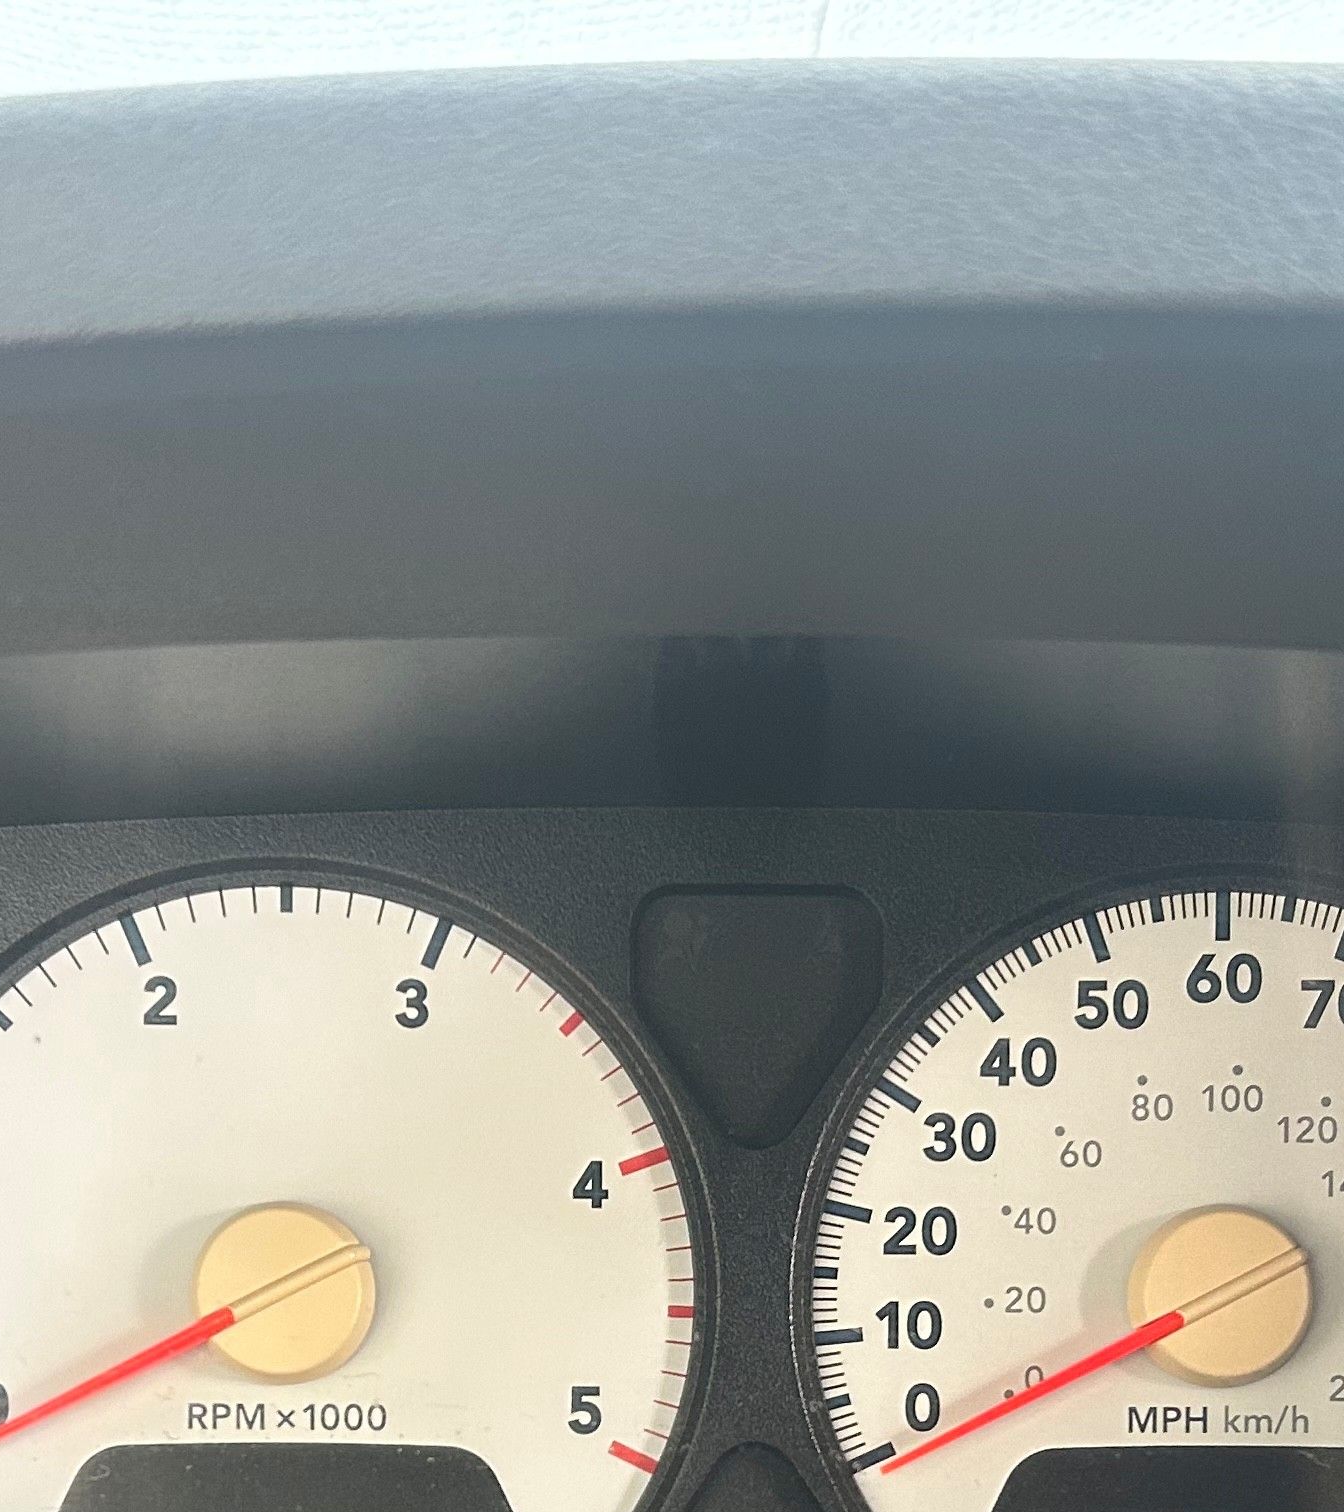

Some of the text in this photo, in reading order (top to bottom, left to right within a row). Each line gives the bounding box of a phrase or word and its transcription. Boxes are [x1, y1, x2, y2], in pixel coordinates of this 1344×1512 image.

[144, 976, 177, 1025] 2
[1186, 953, 1262, 1003] 60
[395, 979, 429, 1029] 3
[1074, 980, 1148, 1030] 50
[980, 1037, 1057, 1087] 40
[1132, 1094, 1173, 1121] 80
[1202, 1085, 1263, 1112] 100
[923, 1113, 996, 1162] 30
[1060, 1140, 1102, 1167] 60
[1277, 1116, 1337, 1144] 120
[573, 1161, 608, 1208] 4
[883, 1207, 957, 1255] 20
[1014, 1207, 1056, 1234] 40
[1005, 1287, 1046, 1313] 20
[876, 1301, 942, 1349] 10
[188, 1403, 265, 1430] RPM
[568, 1386, 601, 1435] 5
[905, 1383, 940, 1432] 0
[1129, 1405, 1309, 1434] MPH km/h
